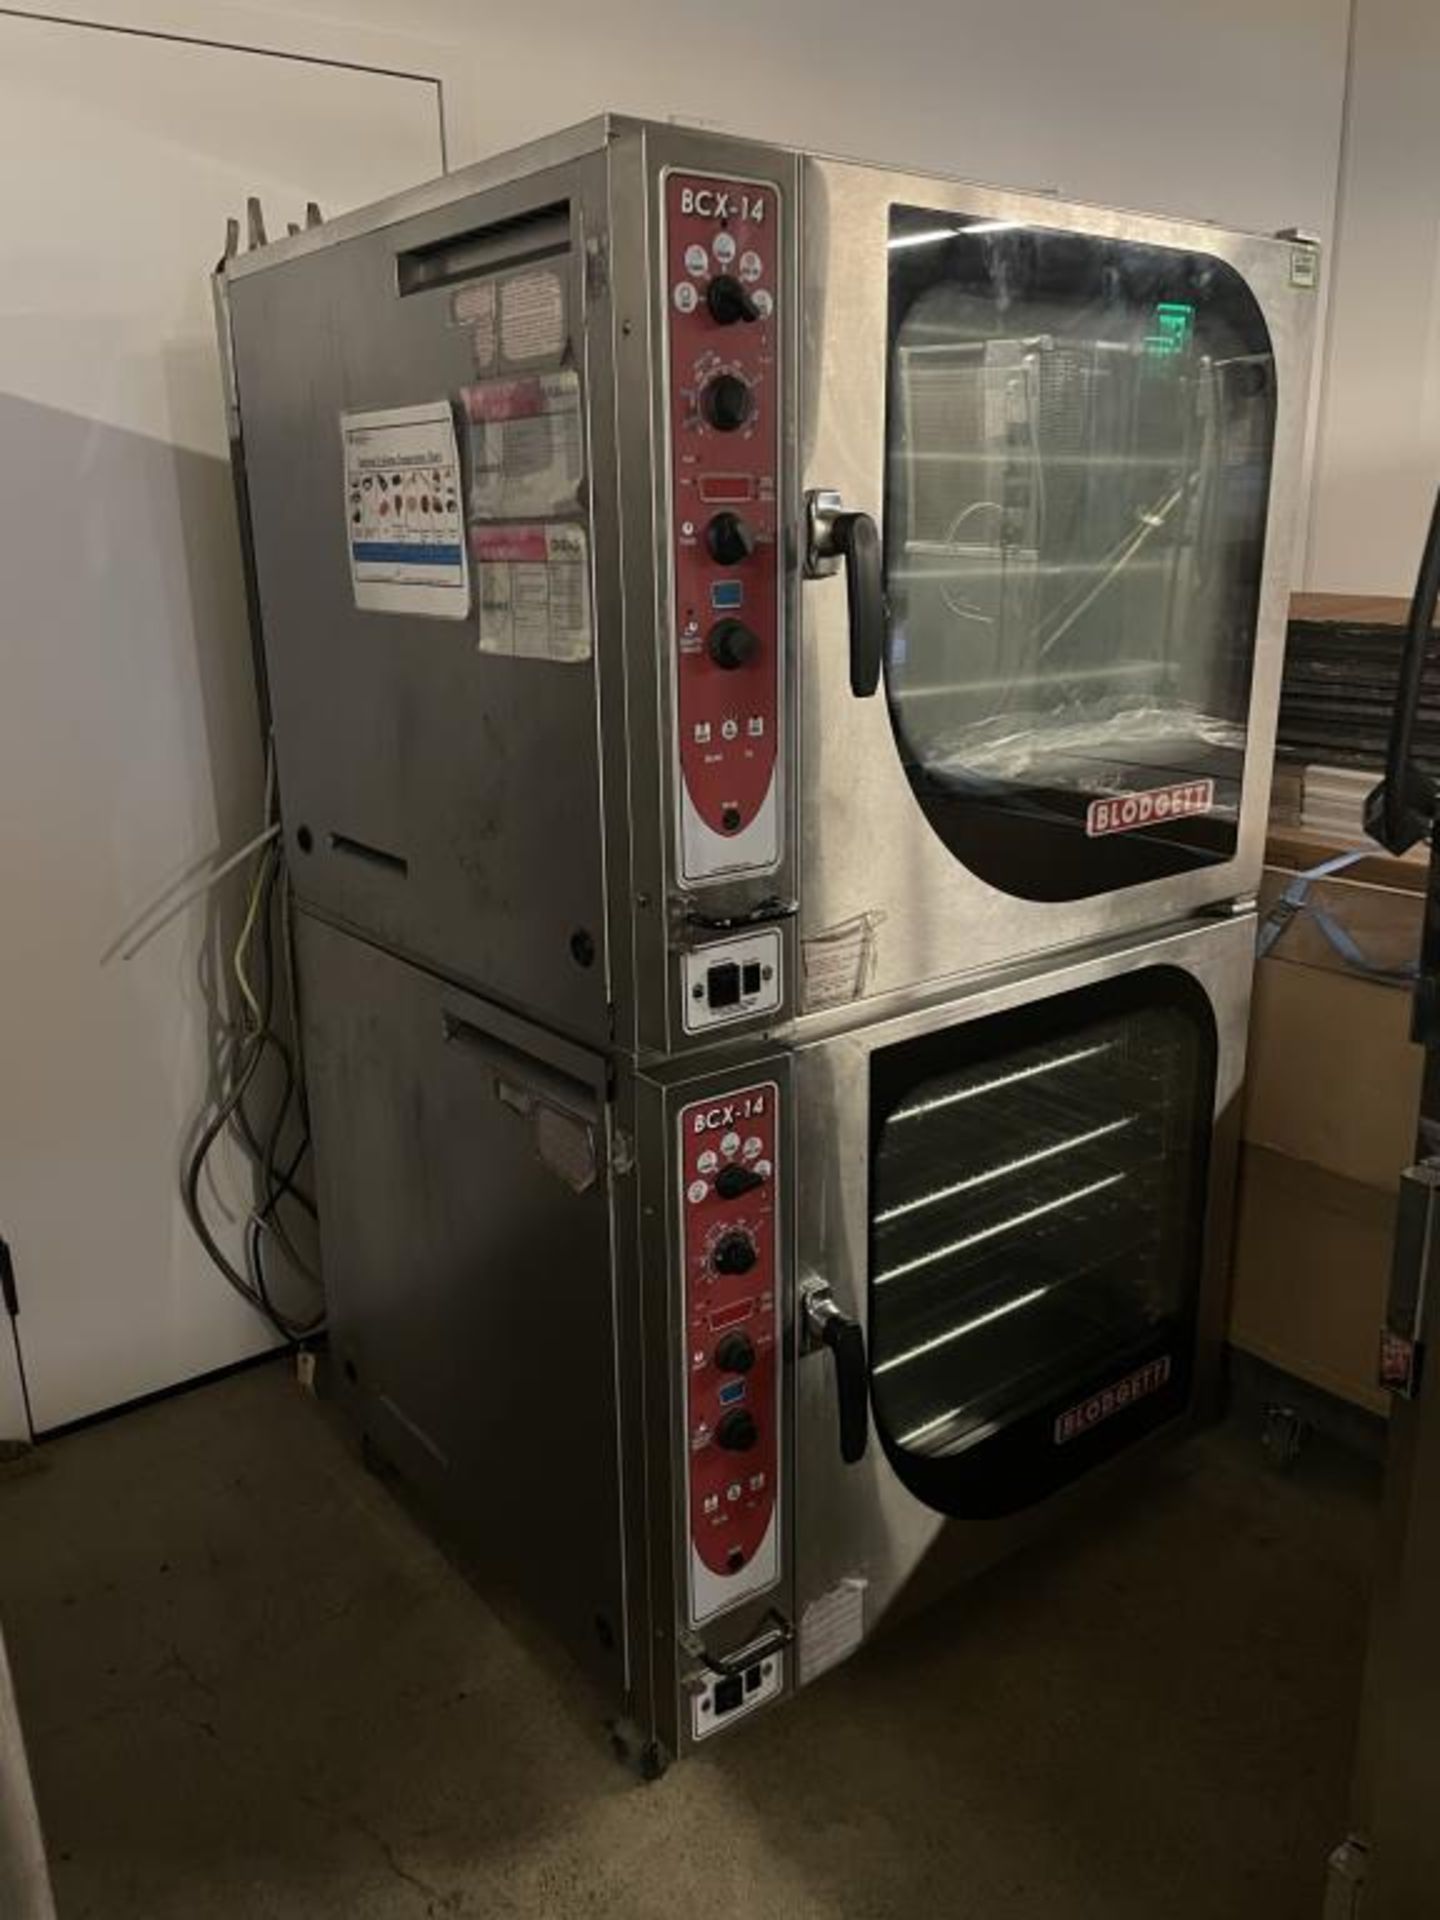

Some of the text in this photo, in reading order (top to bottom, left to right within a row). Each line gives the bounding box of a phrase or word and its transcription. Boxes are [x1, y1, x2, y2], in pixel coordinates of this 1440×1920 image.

[681, 187, 763, 222] BCX-14
[1096, 785, 1206, 830] BLODGETT
[694, 1096, 764, 1133] BCX-14
